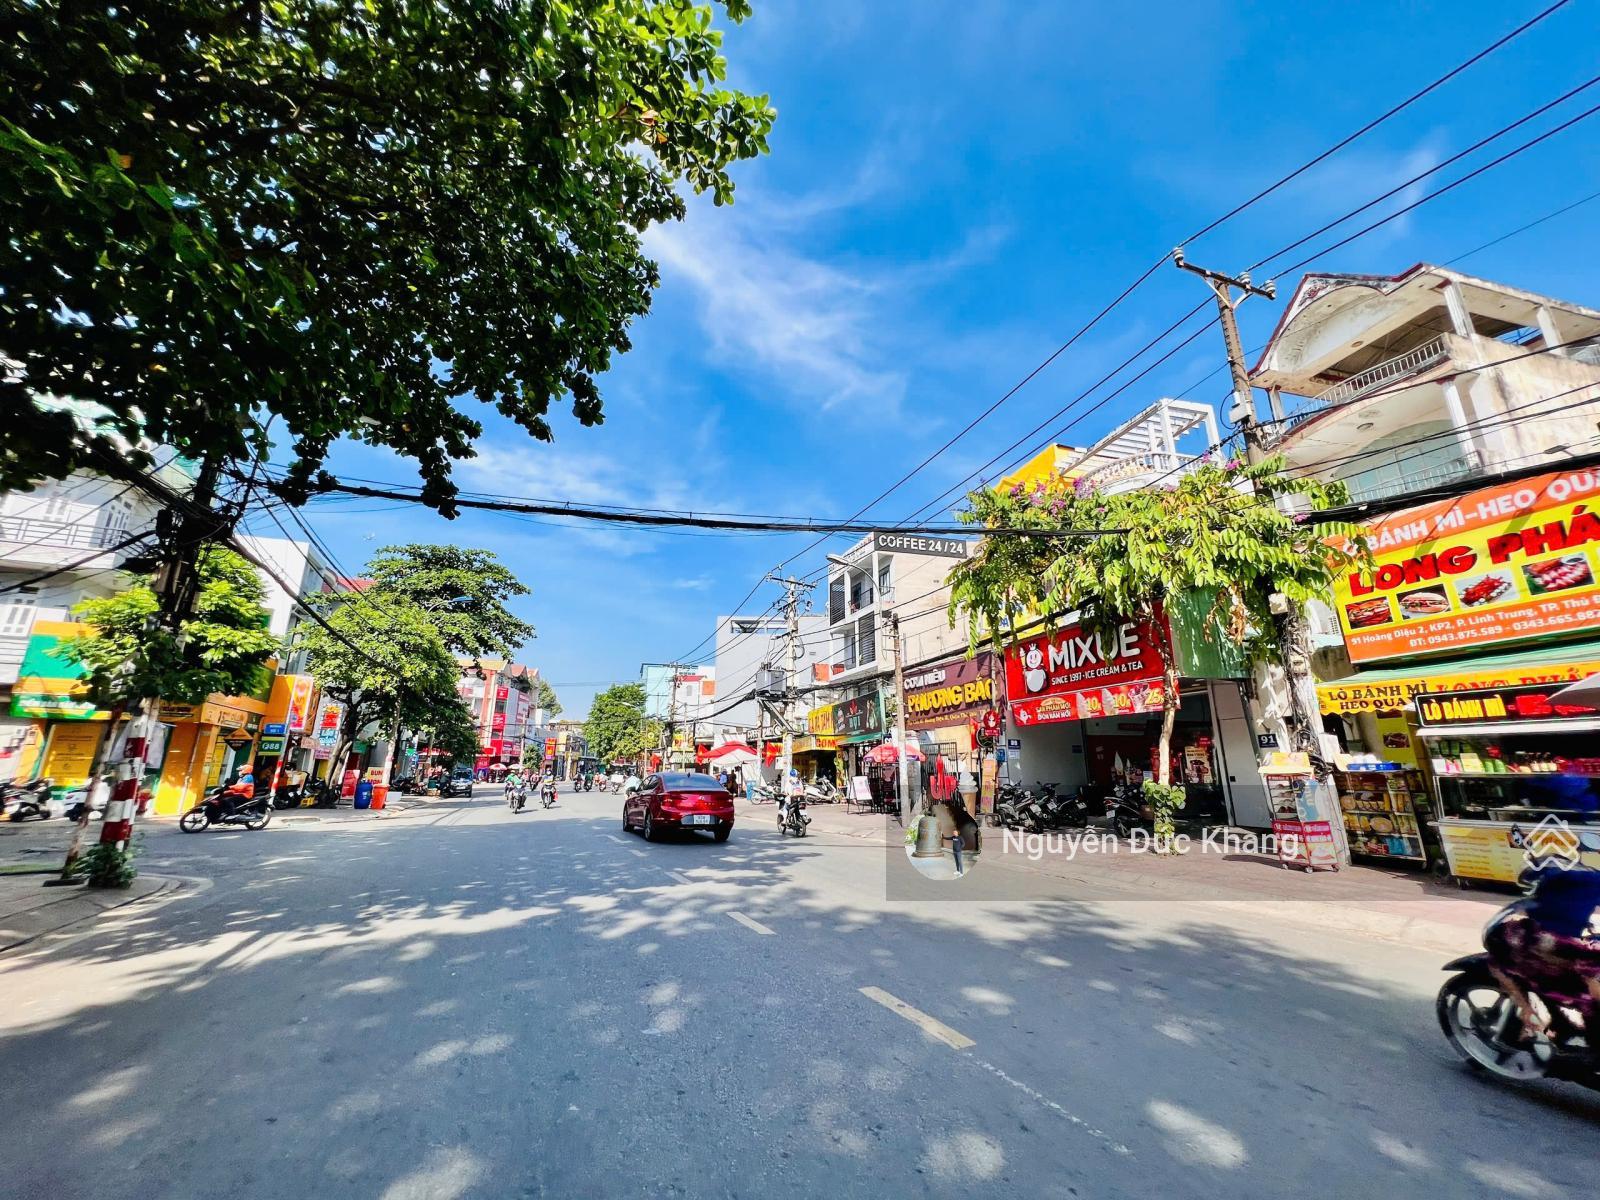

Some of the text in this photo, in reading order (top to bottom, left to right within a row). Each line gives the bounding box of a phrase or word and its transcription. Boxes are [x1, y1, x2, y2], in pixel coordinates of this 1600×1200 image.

[1367, 522, 1429, 551] BÁNH
[1546, 472, 1600, 501] QU
[878, 535, 927, 551] COFFEE
[1349, 545, 1478, 596] LONG
[1468, 614, 1495, 625] Linh
[1047, 621, 1141, 673] MIXUE
[1051, 675, 1069, 686] SINCE
[1096, 664, 1120, 677] CREAM
[1121, 663, 1127, 672] &
[1128, 660, 1144, 671] TEA
[1328, 688, 1348, 701] LÒ
[1352, 685, 1402, 700] BÁNH
[1340, 700, 1370, 710] HEO
[1422, 698, 1443, 720] LÒ
[1442, 697, 1484, 720] BÁNH
[1260, 735, 1276, 745] 91
